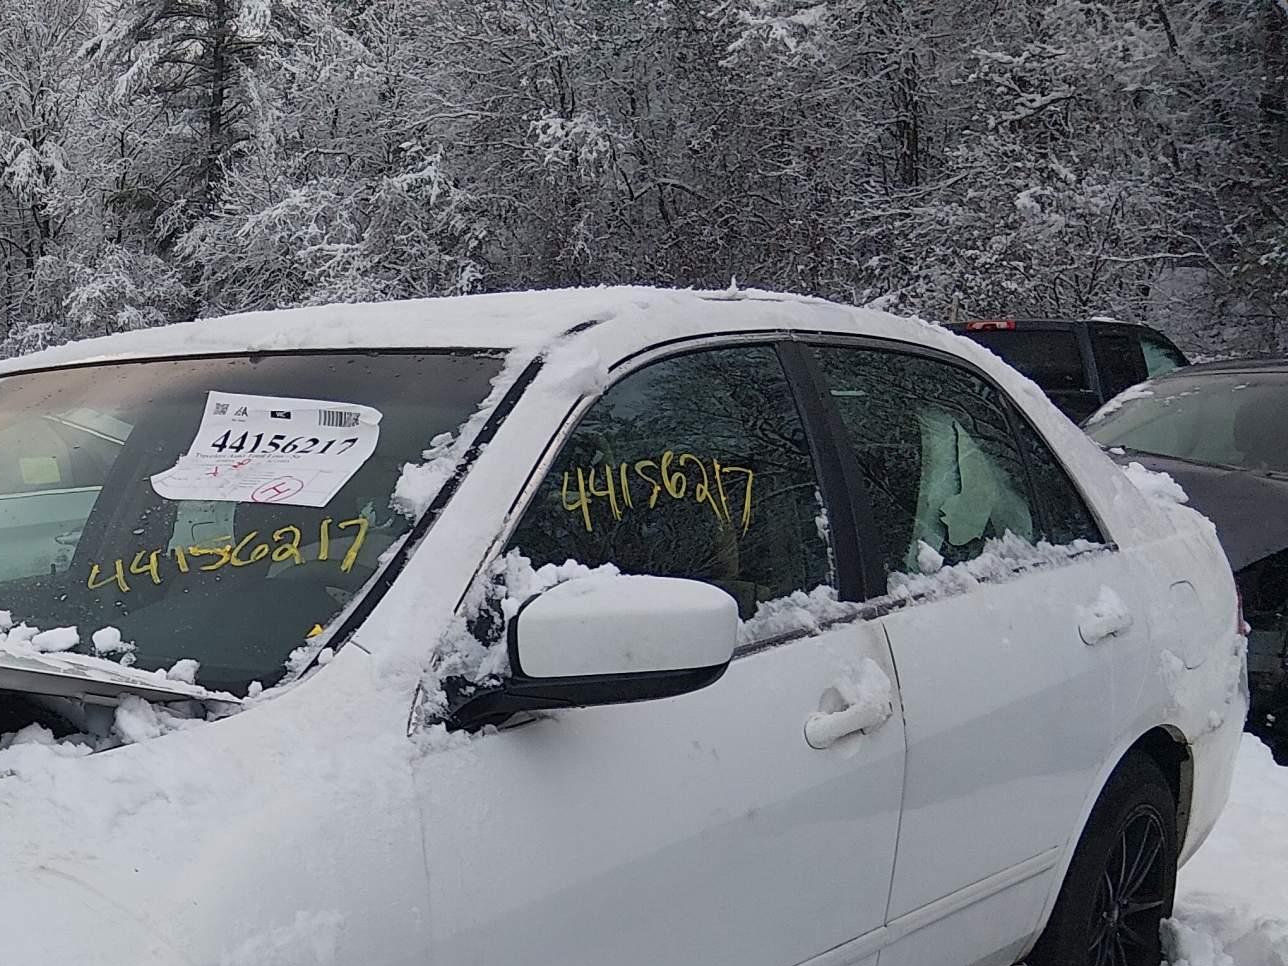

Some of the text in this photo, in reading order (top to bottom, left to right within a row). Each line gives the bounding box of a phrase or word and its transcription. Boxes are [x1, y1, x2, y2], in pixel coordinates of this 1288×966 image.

[211, 429, 359, 456] 44156217
[561, 449, 754, 538] 44156217
[87, 516, 370, 593] 44156217
